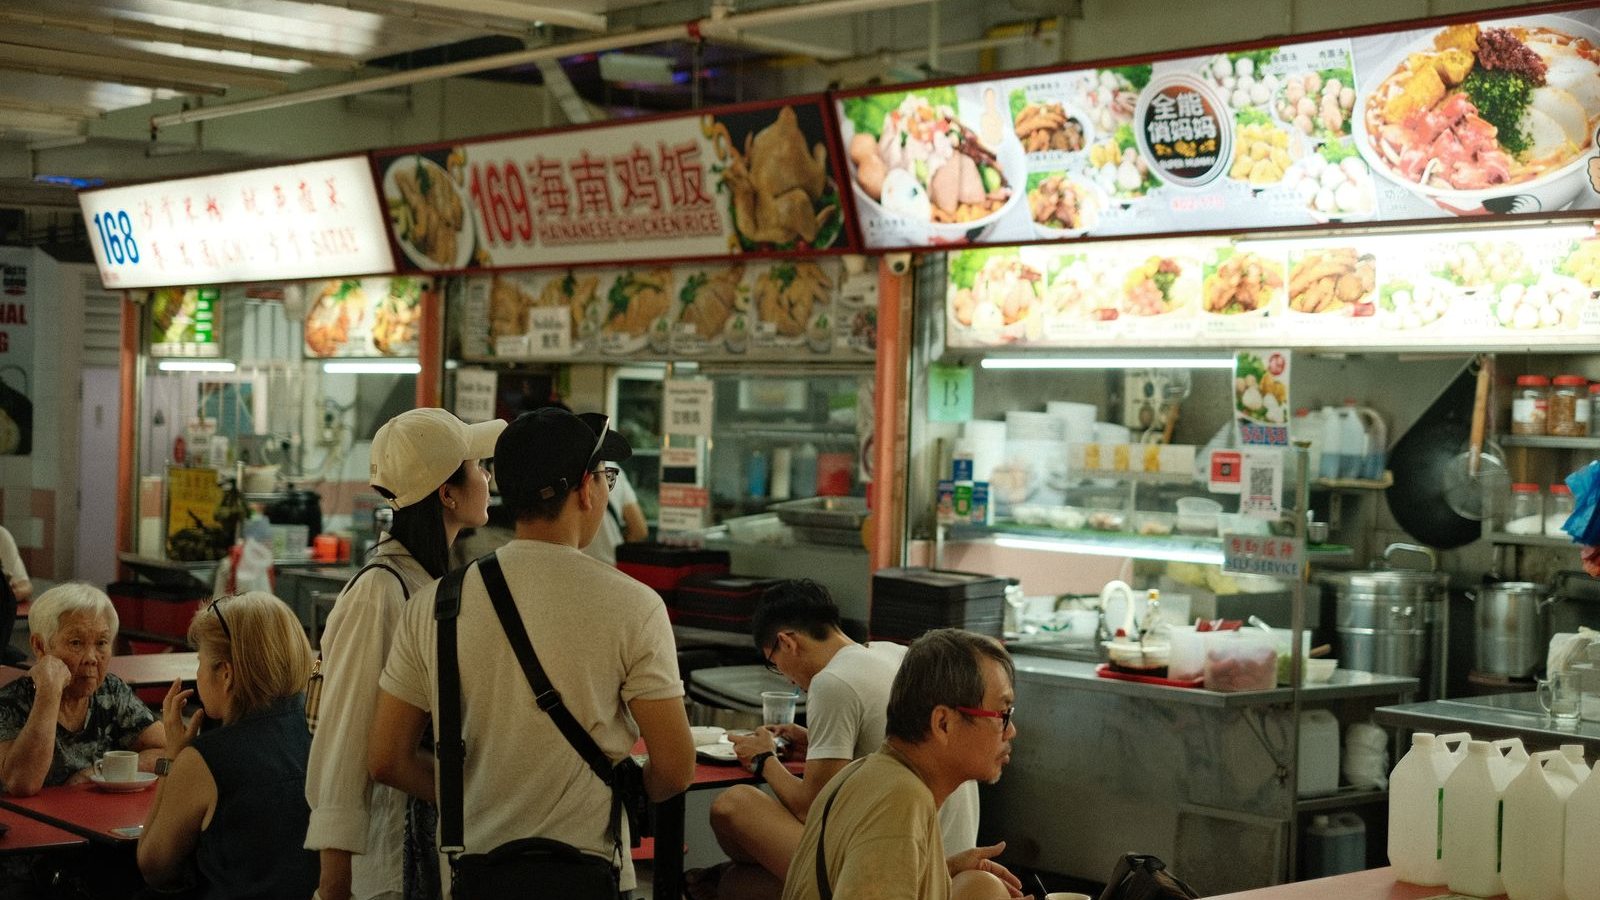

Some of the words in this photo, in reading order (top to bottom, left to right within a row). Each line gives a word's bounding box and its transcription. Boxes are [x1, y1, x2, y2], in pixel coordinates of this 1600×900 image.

[1151, 91, 1205, 120] 全能
[470, 162, 533, 243] 169
[527, 141, 712, 217] 海南鸡饭
[94, 210, 139, 264] 168
[540, 219, 613, 241] HAINANESE
[617, 213, 681, 237] CHICKEN
[684, 211, 720, 233] RICE
